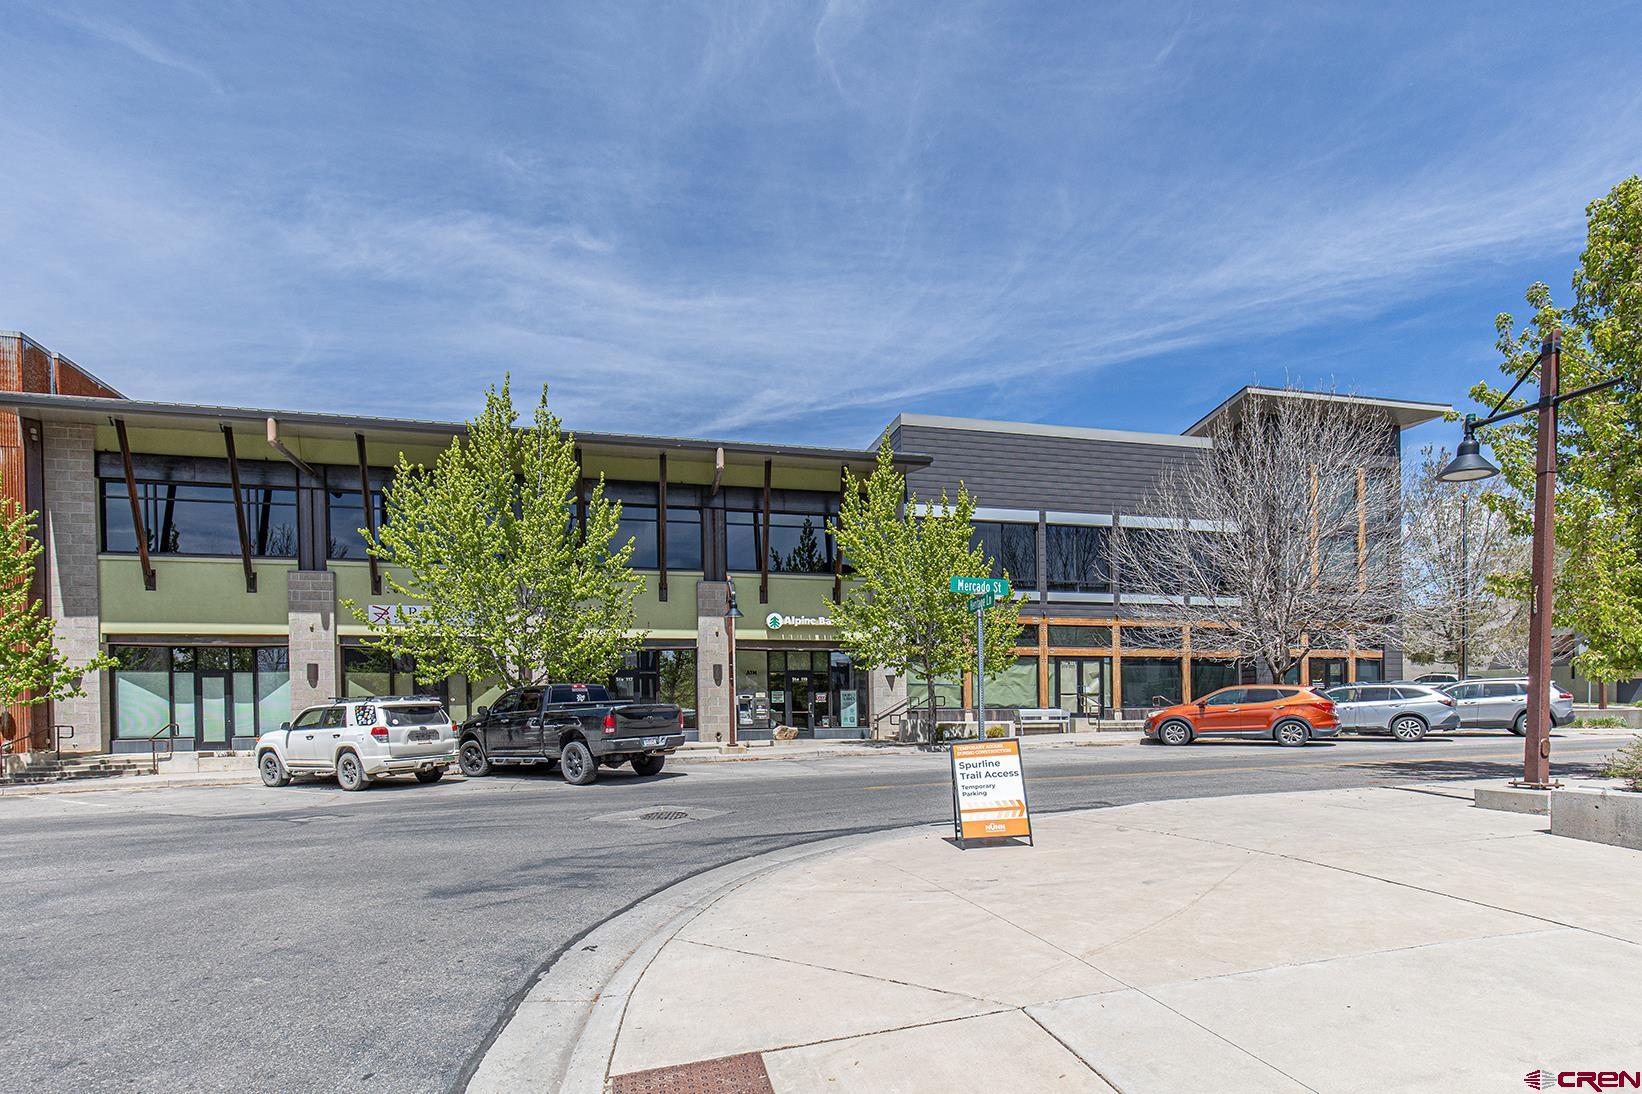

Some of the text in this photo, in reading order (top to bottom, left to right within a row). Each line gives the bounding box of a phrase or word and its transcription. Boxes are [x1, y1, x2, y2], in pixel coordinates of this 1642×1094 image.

[957, 579, 1002, 593] Mercado St
[783, 615, 817, 627] Alpine
[958, 760, 1001, 771] Spurline
[960, 770, 1020, 781] Trail Access
